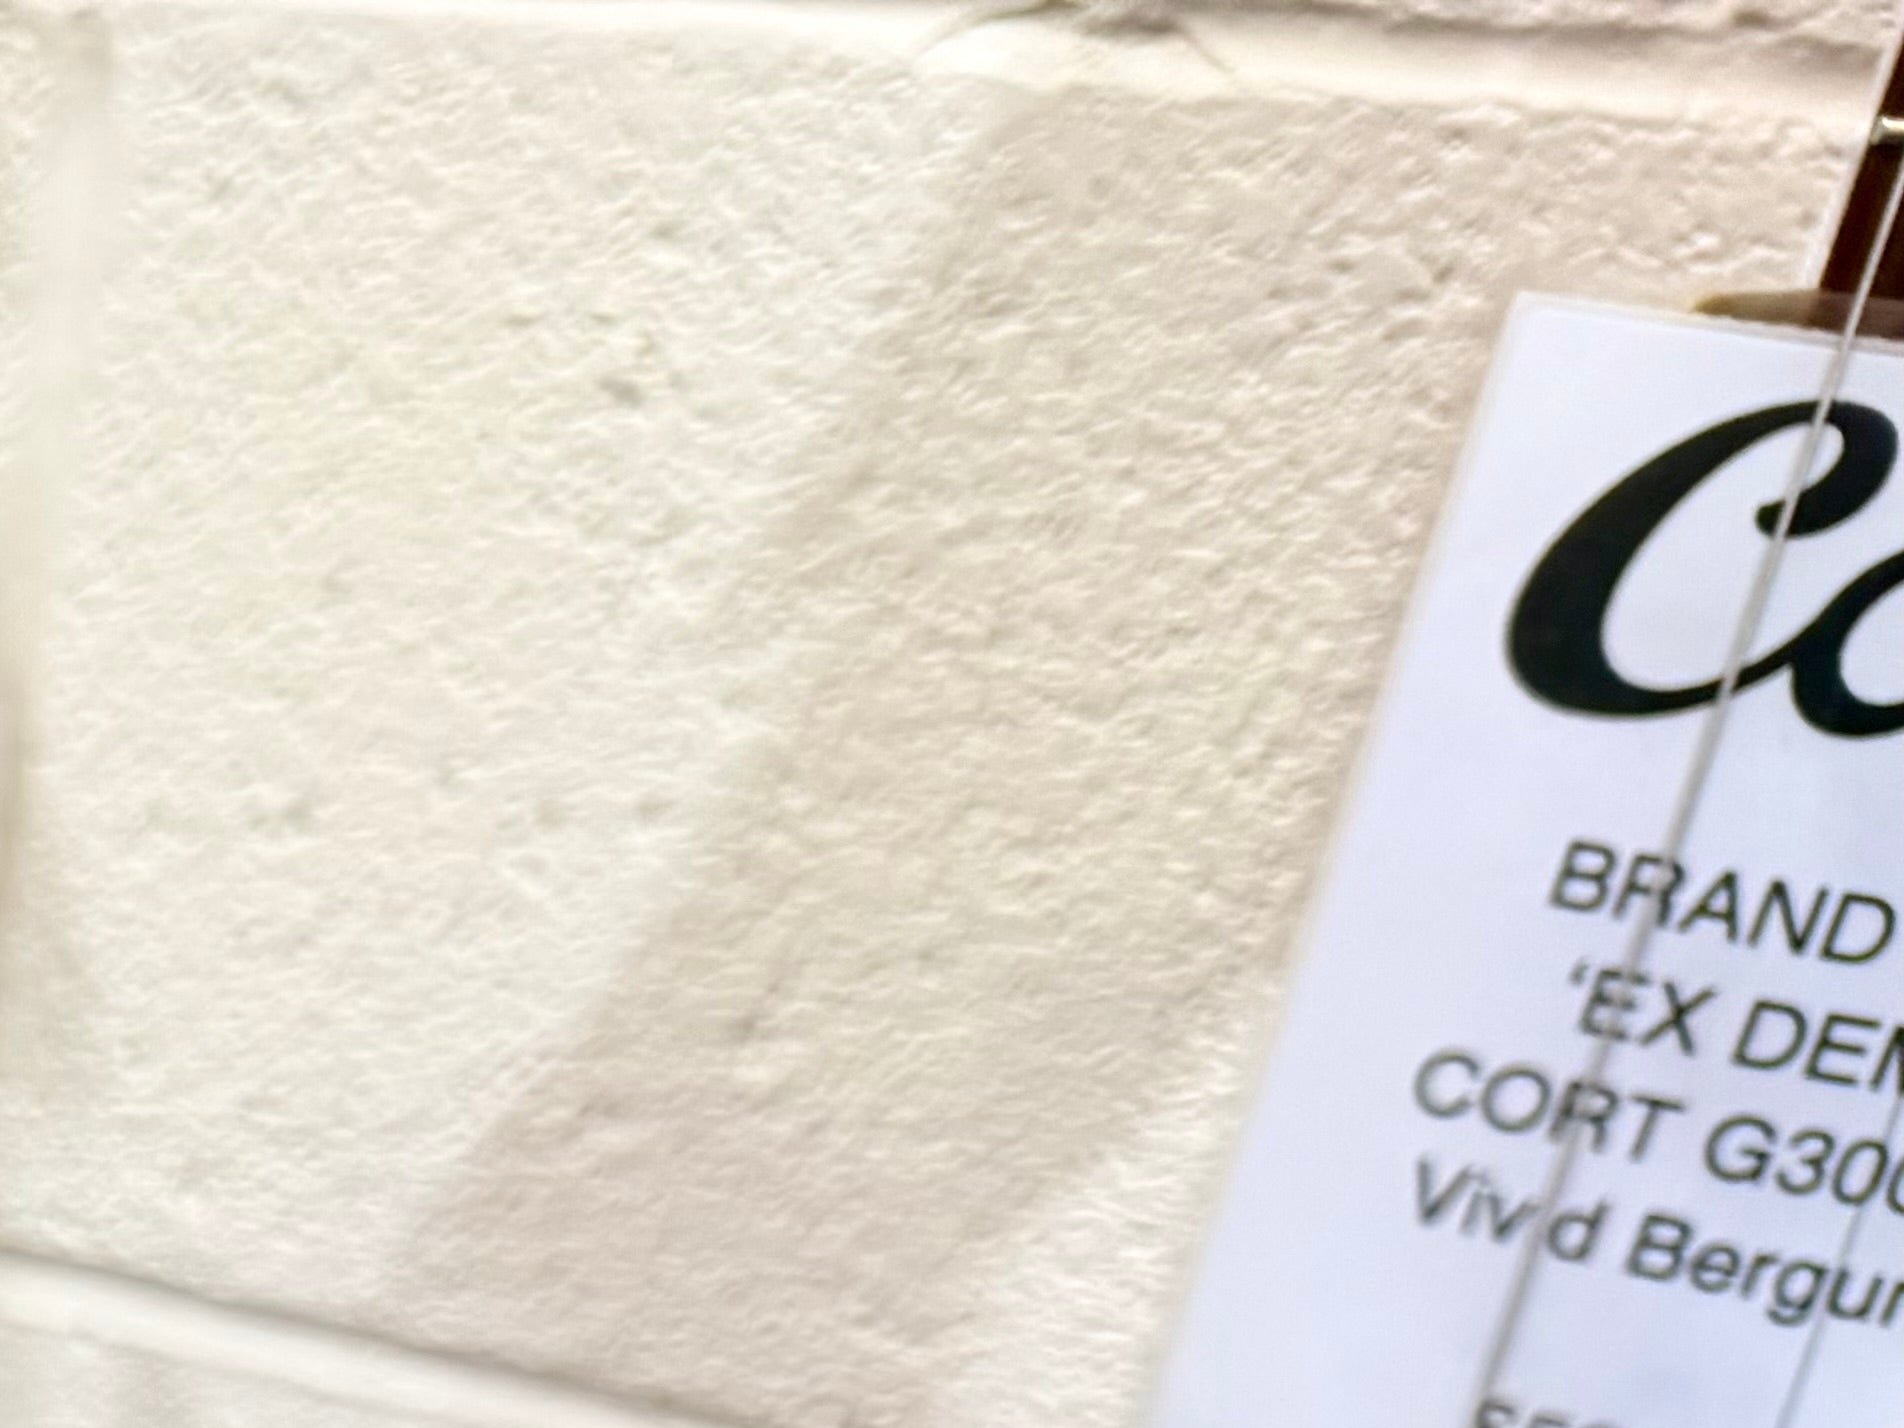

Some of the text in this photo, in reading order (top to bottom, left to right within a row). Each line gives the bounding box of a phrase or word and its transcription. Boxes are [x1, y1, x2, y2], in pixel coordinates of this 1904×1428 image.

[1548, 838, 1896, 965] BRAND
[1413, 1046, 1686, 1165] CORT
[1416, 1155, 1610, 1265] Vivd
